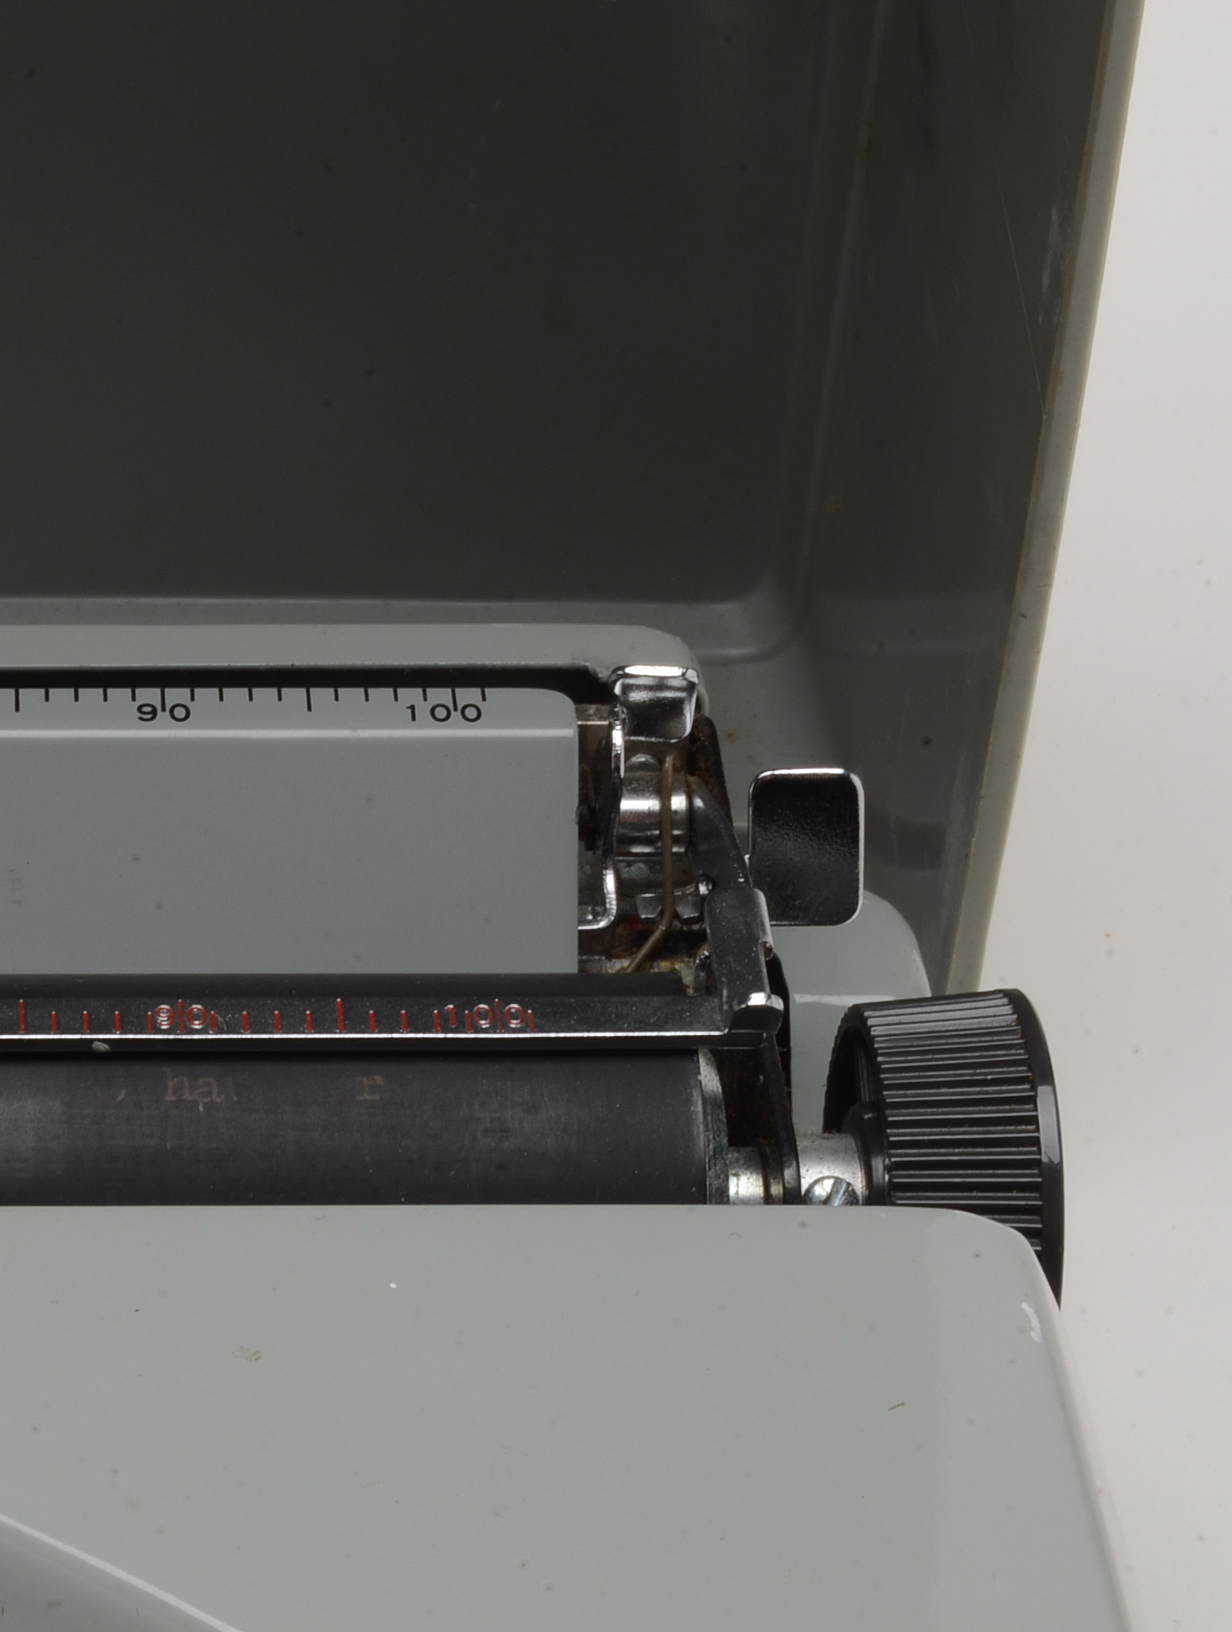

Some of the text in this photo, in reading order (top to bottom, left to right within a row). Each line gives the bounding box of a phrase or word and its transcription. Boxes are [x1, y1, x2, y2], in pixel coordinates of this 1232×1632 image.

[135, 703, 192, 723] 90
[405, 703, 483, 723] 100
[153, 1004, 208, 1030] 90
[444, 1003, 526, 1029] 100
